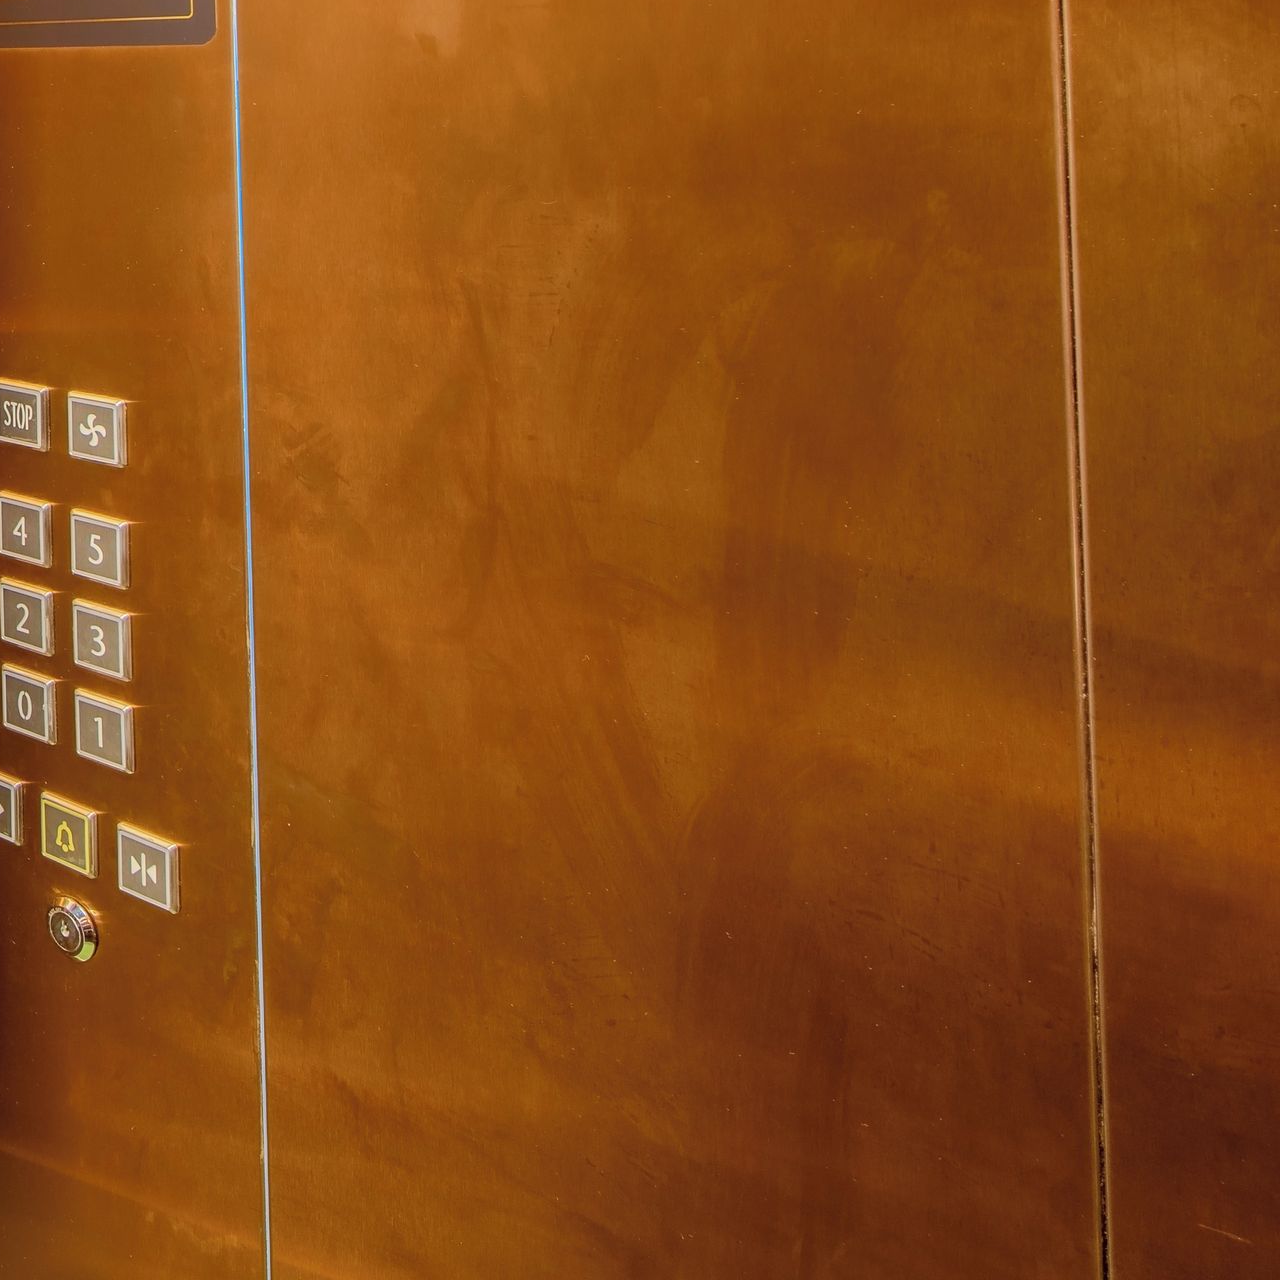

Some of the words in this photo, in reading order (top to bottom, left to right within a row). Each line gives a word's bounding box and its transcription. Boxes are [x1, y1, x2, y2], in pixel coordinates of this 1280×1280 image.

[3, 400, 33, 431] STOP
[12, 516, 28, 546] 4
[88, 534, 104, 565] 5
[15, 602, 30, 635] 2
[90, 625, 106, 657] 3
[17, 690, 33, 721] 0
[93, 716, 103, 748] 1
